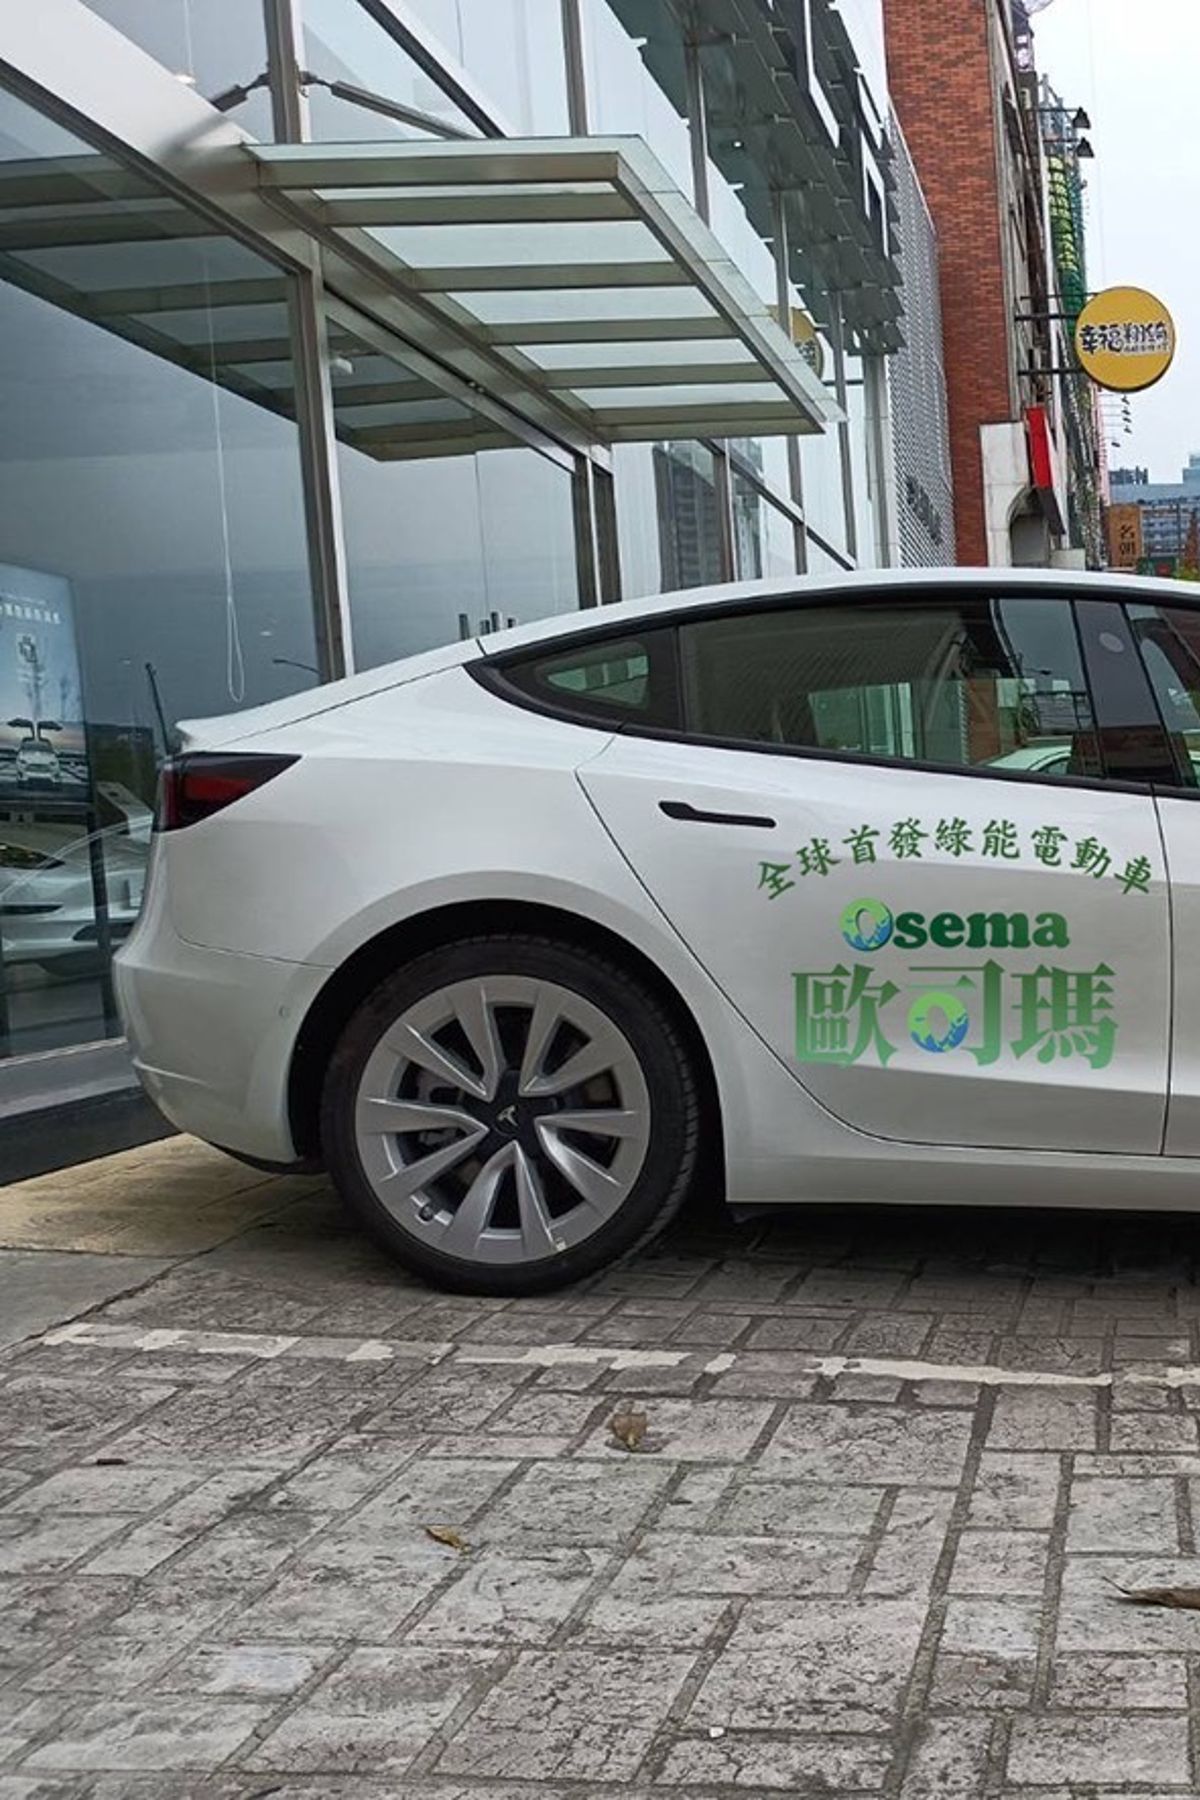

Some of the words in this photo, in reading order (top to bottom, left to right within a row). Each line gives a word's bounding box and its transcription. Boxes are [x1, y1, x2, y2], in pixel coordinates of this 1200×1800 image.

[758, 817, 1153, 899] 全球首發綠能電動車
[840, 898, 1070, 952] Osema
[791, 959, 1119, 1069] 歐司瑪
